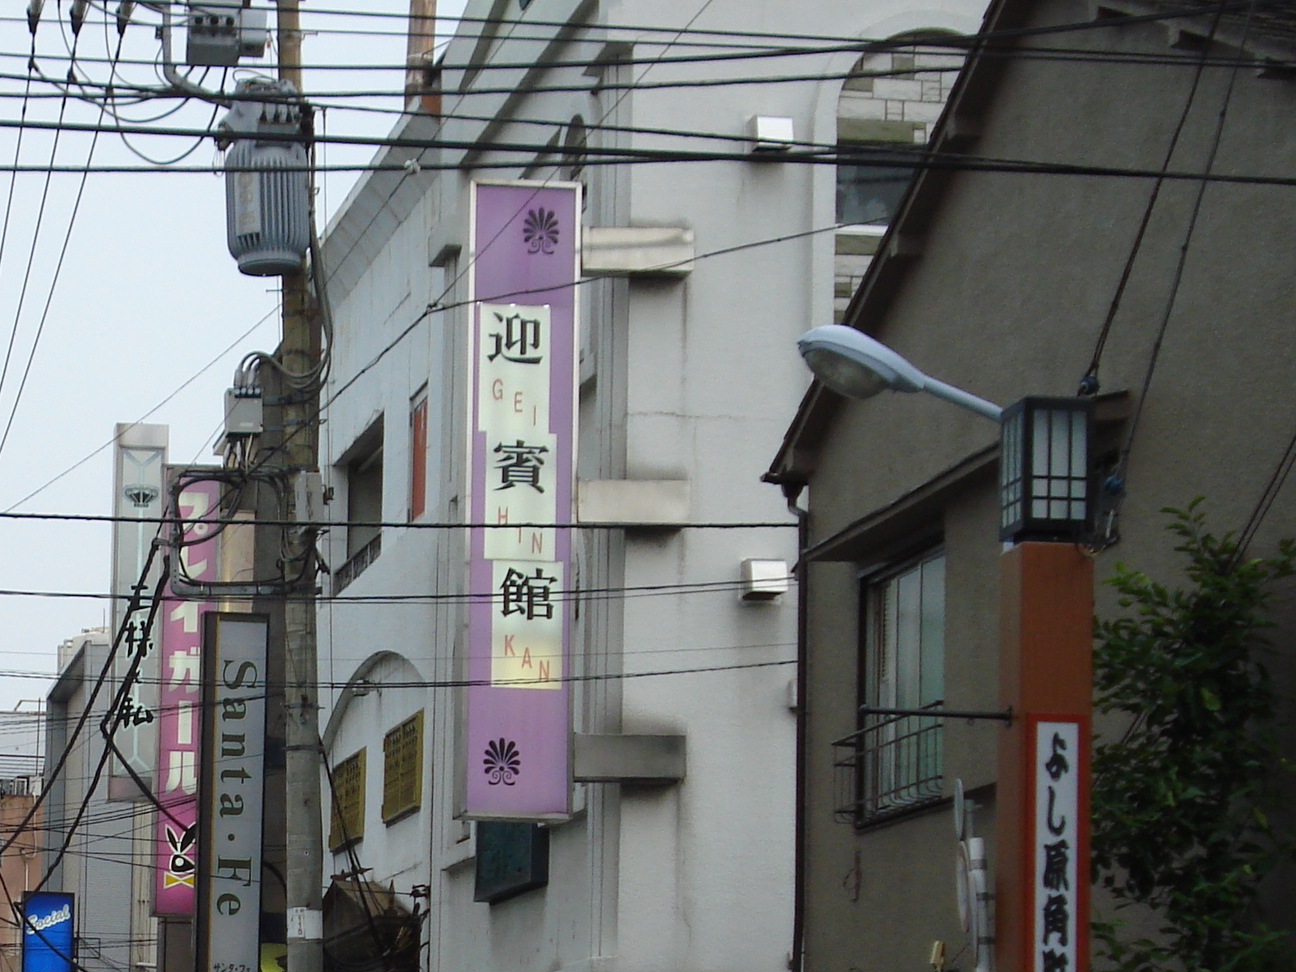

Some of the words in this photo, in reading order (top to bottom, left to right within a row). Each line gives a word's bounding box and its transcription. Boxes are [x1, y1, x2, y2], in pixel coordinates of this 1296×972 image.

[492, 379, 538, 426] GEI
[498, 507, 543, 554] HIN
[166, 490, 212, 798] プレイガール
[504, 634, 550, 680] KAN
[26, 904, 70, 933] Social
